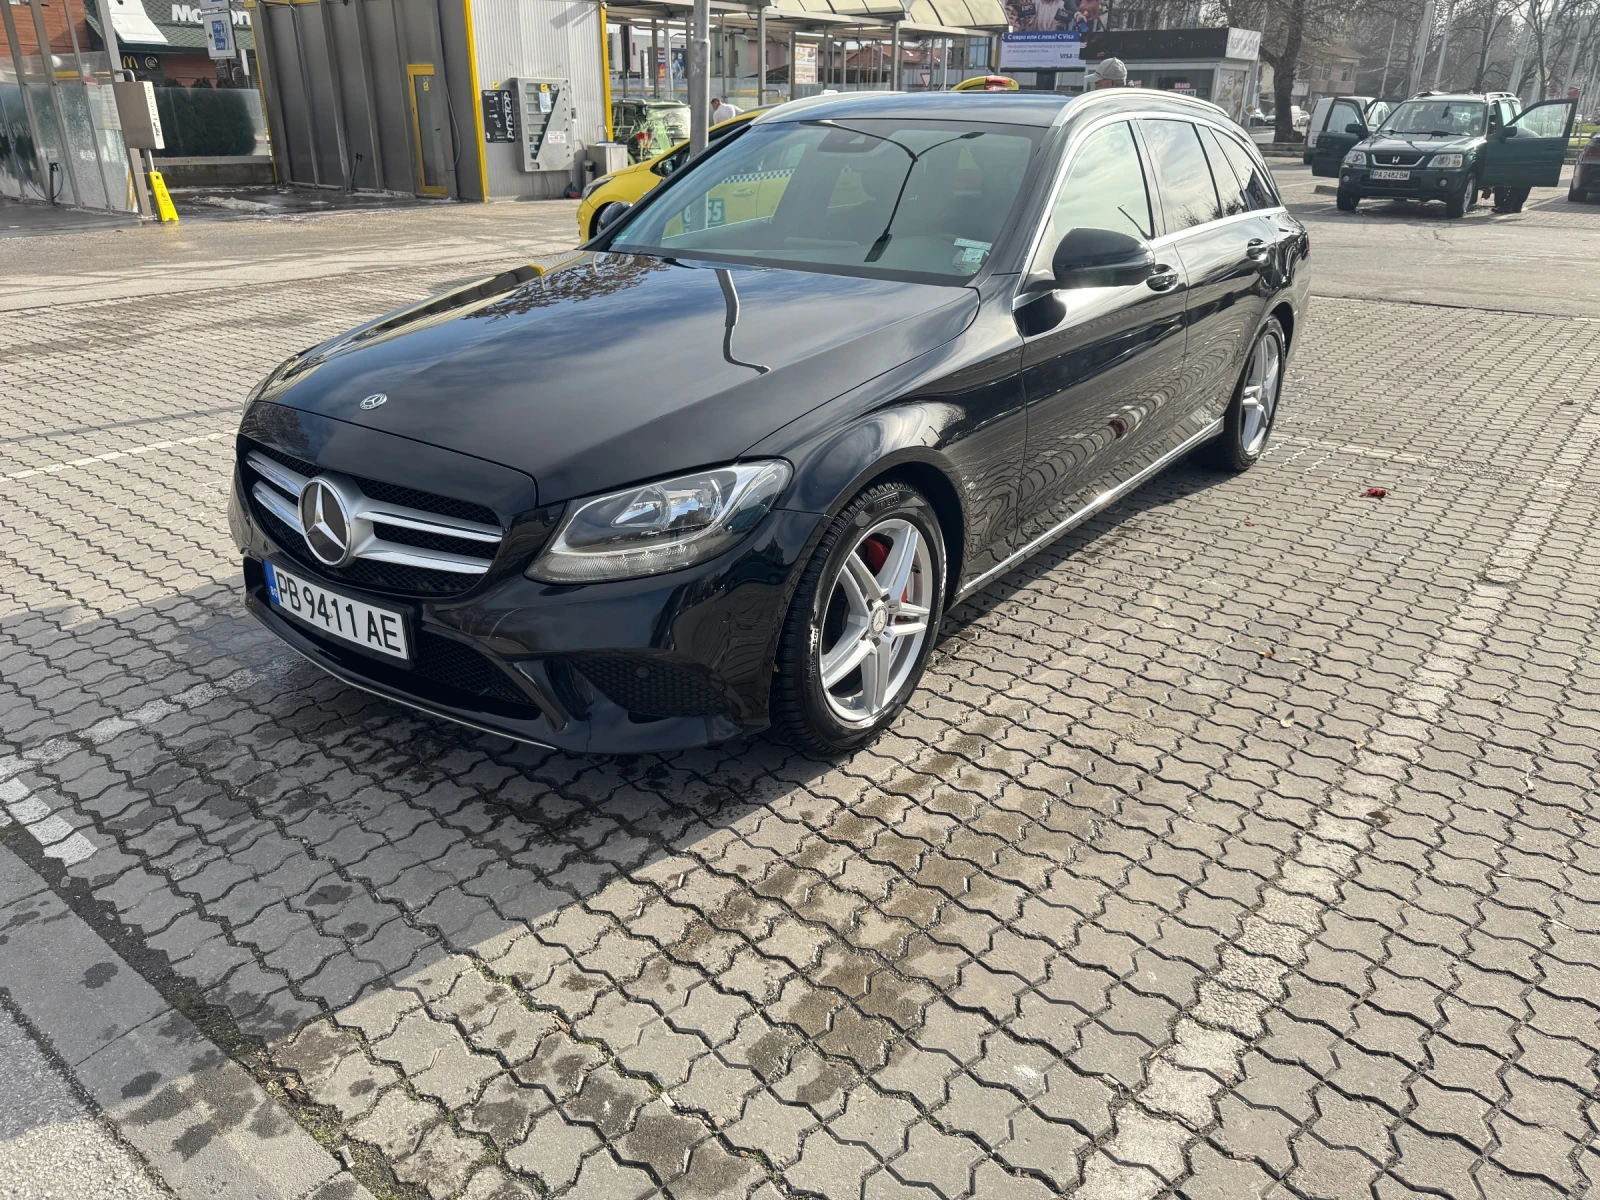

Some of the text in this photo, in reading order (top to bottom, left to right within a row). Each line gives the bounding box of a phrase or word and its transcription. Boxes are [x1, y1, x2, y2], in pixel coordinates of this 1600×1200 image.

[504, 91, 514, 139] PITSTOP
[275, 571, 401, 652] PB 9411 AE
